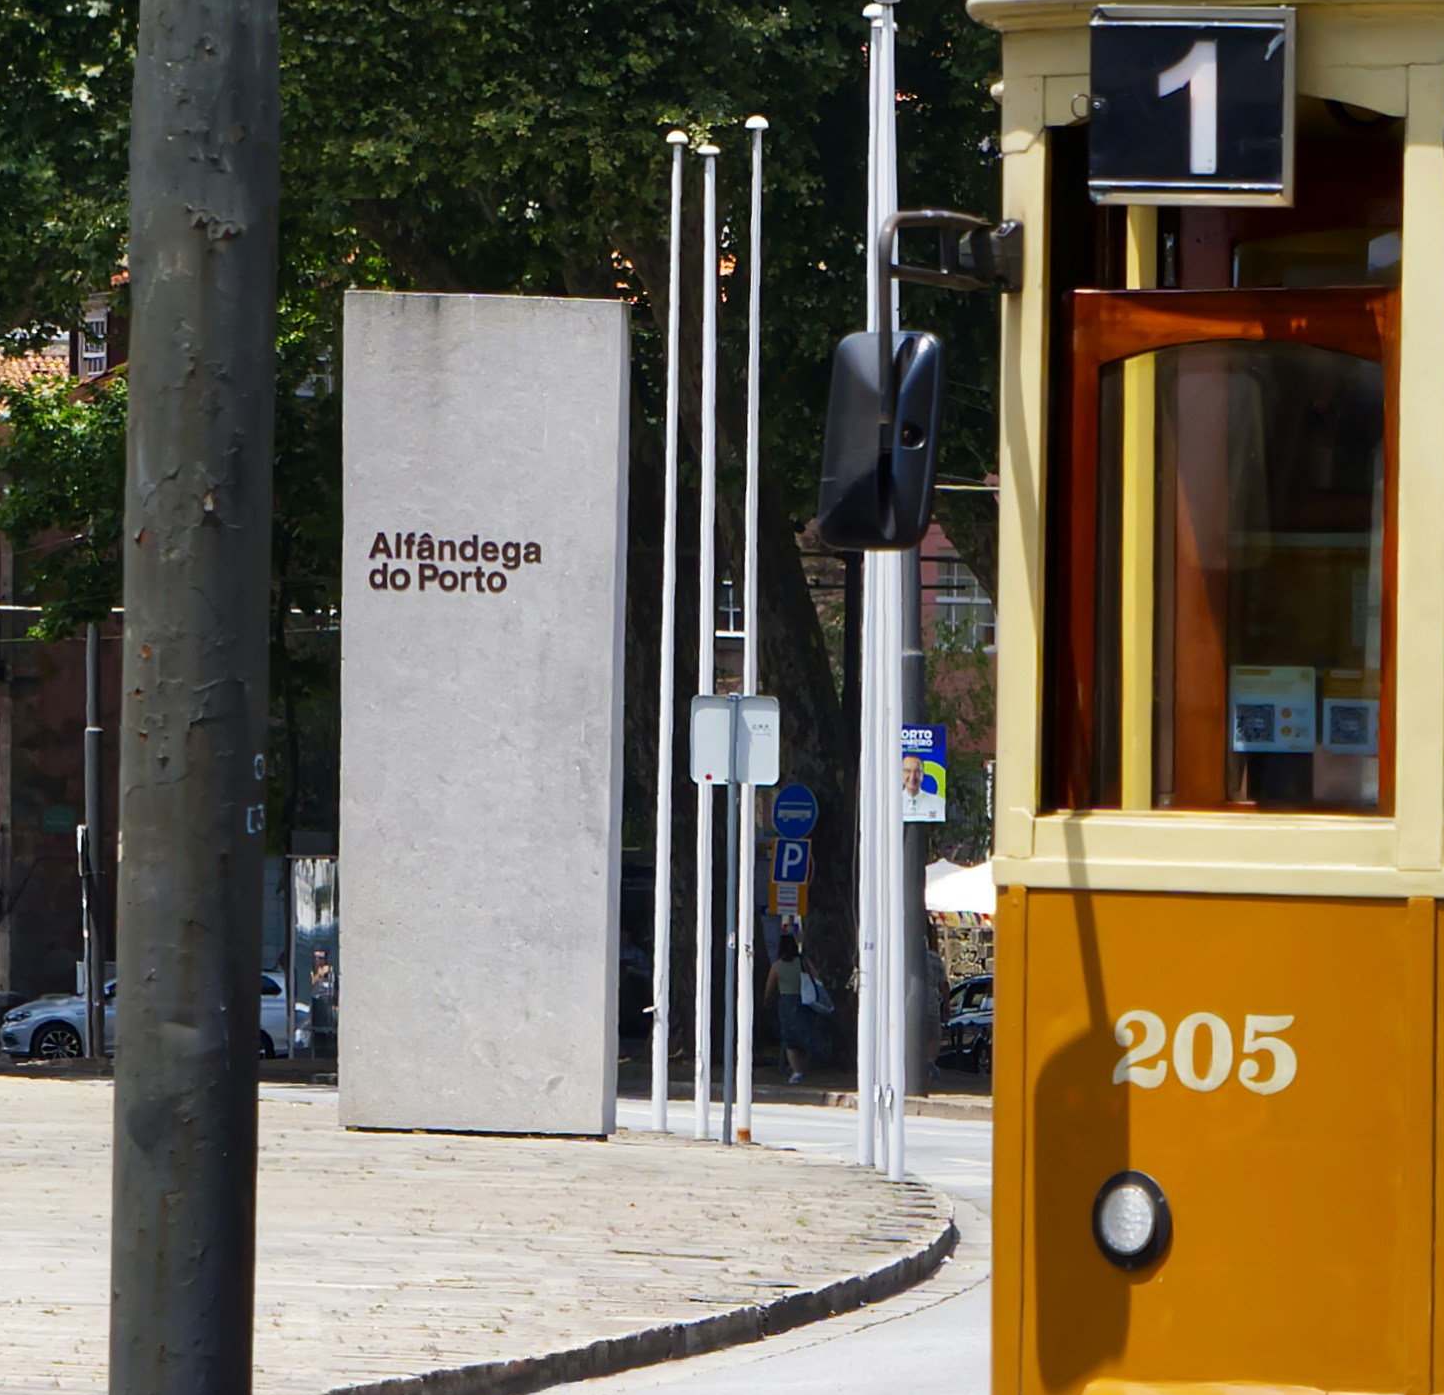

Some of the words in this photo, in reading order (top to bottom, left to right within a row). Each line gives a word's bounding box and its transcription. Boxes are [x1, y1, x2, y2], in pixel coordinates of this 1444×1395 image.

[1156, 38, 1220, 175] 1
[368, 532, 543, 571] Alfândega
[368, 562, 411, 592] do
[418, 563, 508, 593] Porto
[901, 729, 933, 740] ORTO
[781, 842, 804, 879] P
[1112, 1009, 1298, 1096] 205
